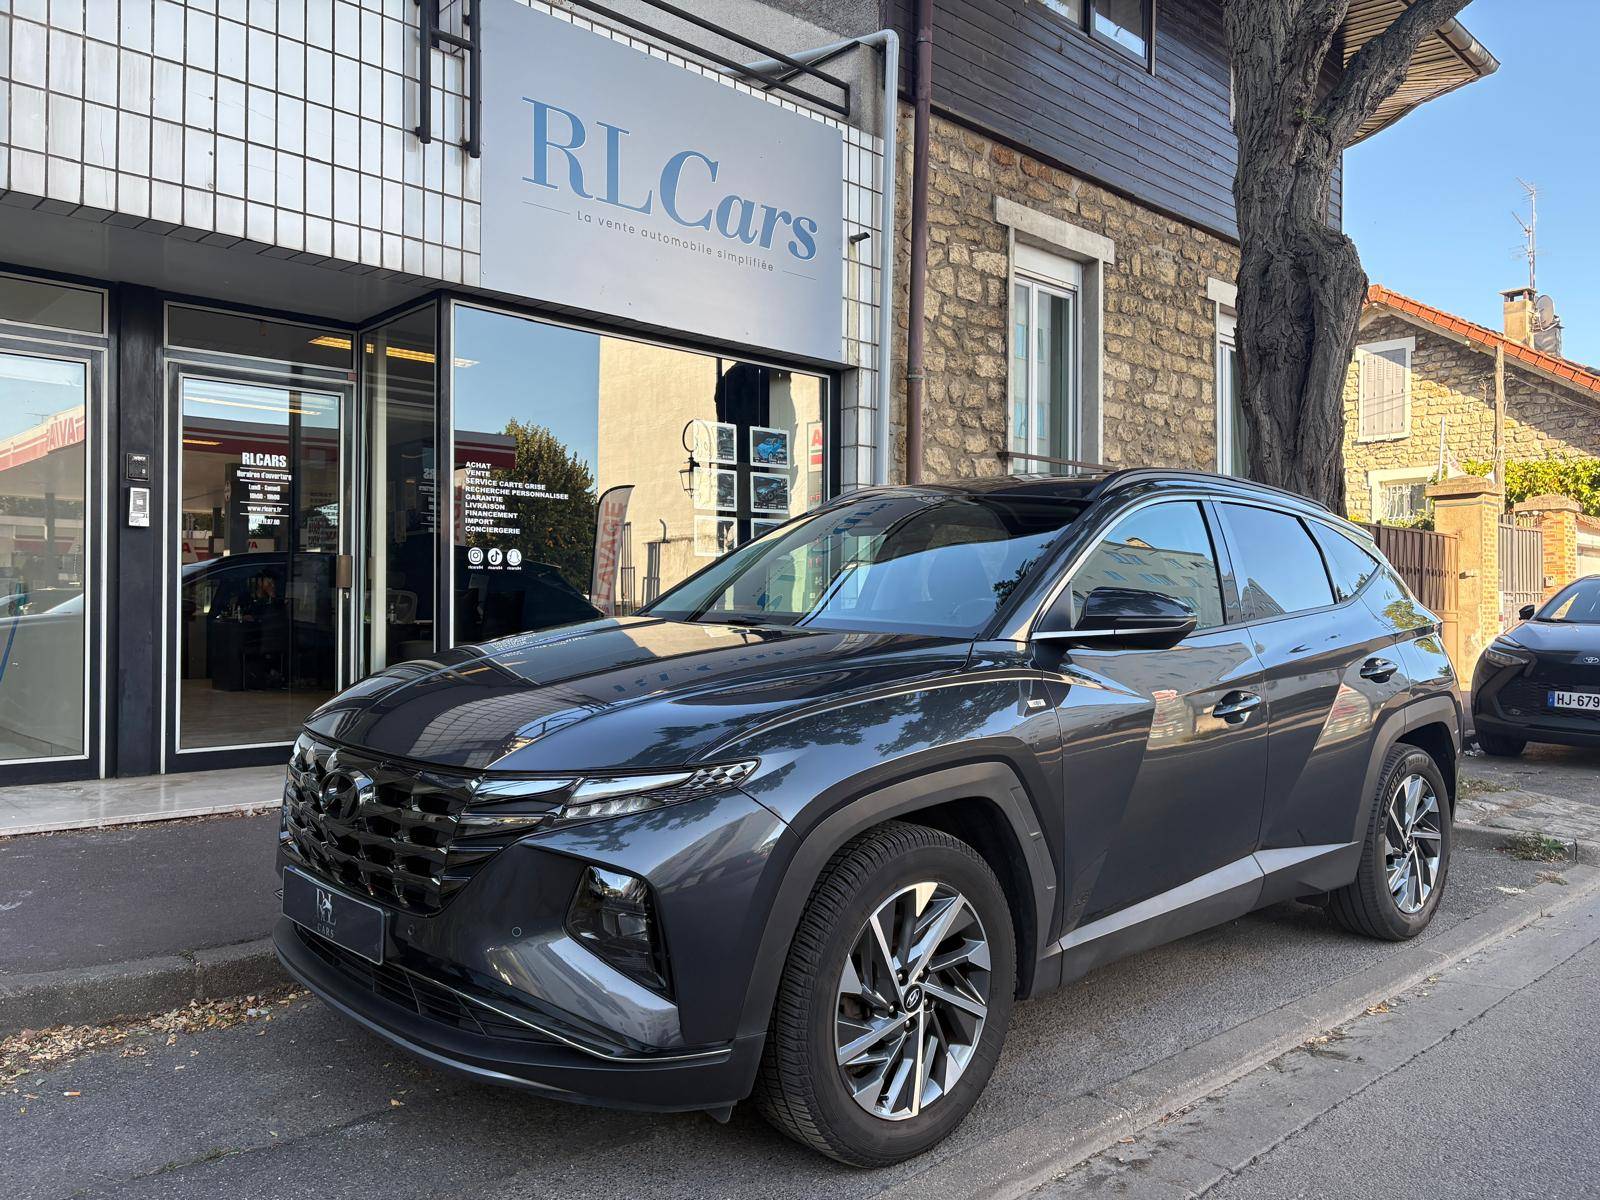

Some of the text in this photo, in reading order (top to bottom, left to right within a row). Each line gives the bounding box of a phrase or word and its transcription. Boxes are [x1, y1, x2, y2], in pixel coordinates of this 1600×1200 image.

[576, 210, 774, 272] La vente automobile simplifiée
[241, 452, 287, 468] RLCARS
[465, 461, 491, 469] ACHAT
[465, 469, 491, 477] VENTE
[465, 477, 546, 491] SERVICE CARTE GRISE
[465, 485, 511, 496] RECHERCHE
[465, 493, 504, 503] GARANTIE
[465, 501, 506, 510] LIVRAISON
[465, 509, 519, 519] FINANCEMENT
[465, 517, 495, 526] IMPORT
[465, 525, 521, 535] CONCIERGERIE
[1557, 693, 1600, 708] HJ-679
